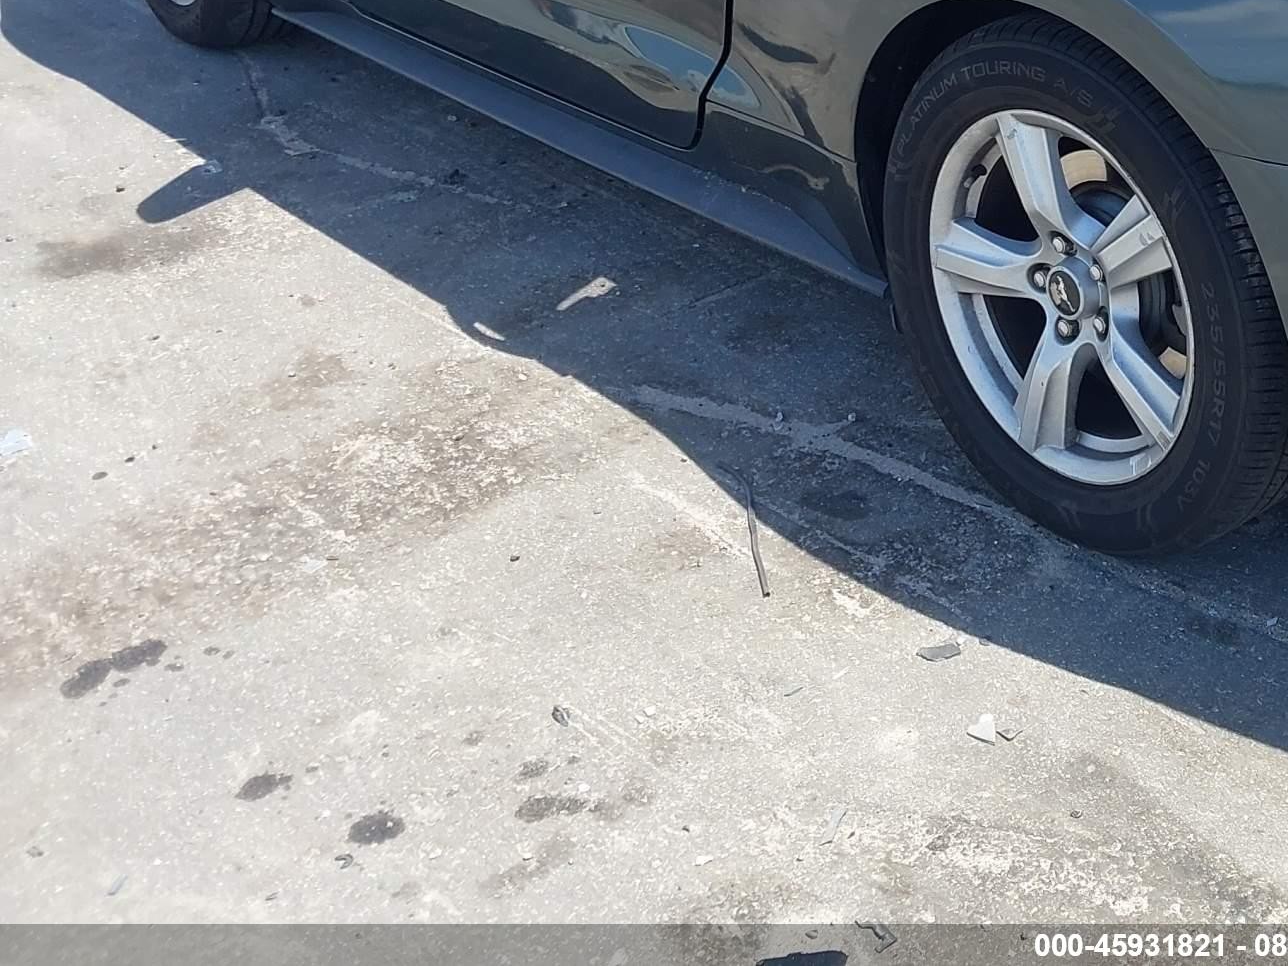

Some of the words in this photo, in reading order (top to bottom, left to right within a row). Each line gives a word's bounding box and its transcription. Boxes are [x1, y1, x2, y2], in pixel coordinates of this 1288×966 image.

[897, 73, 960, 156] PLATINUM
[960, 60, 1047, 82] TOURING
[1053, 78, 1094, 108] A/S
[1202, 283, 1227, 445] 235/55R17
